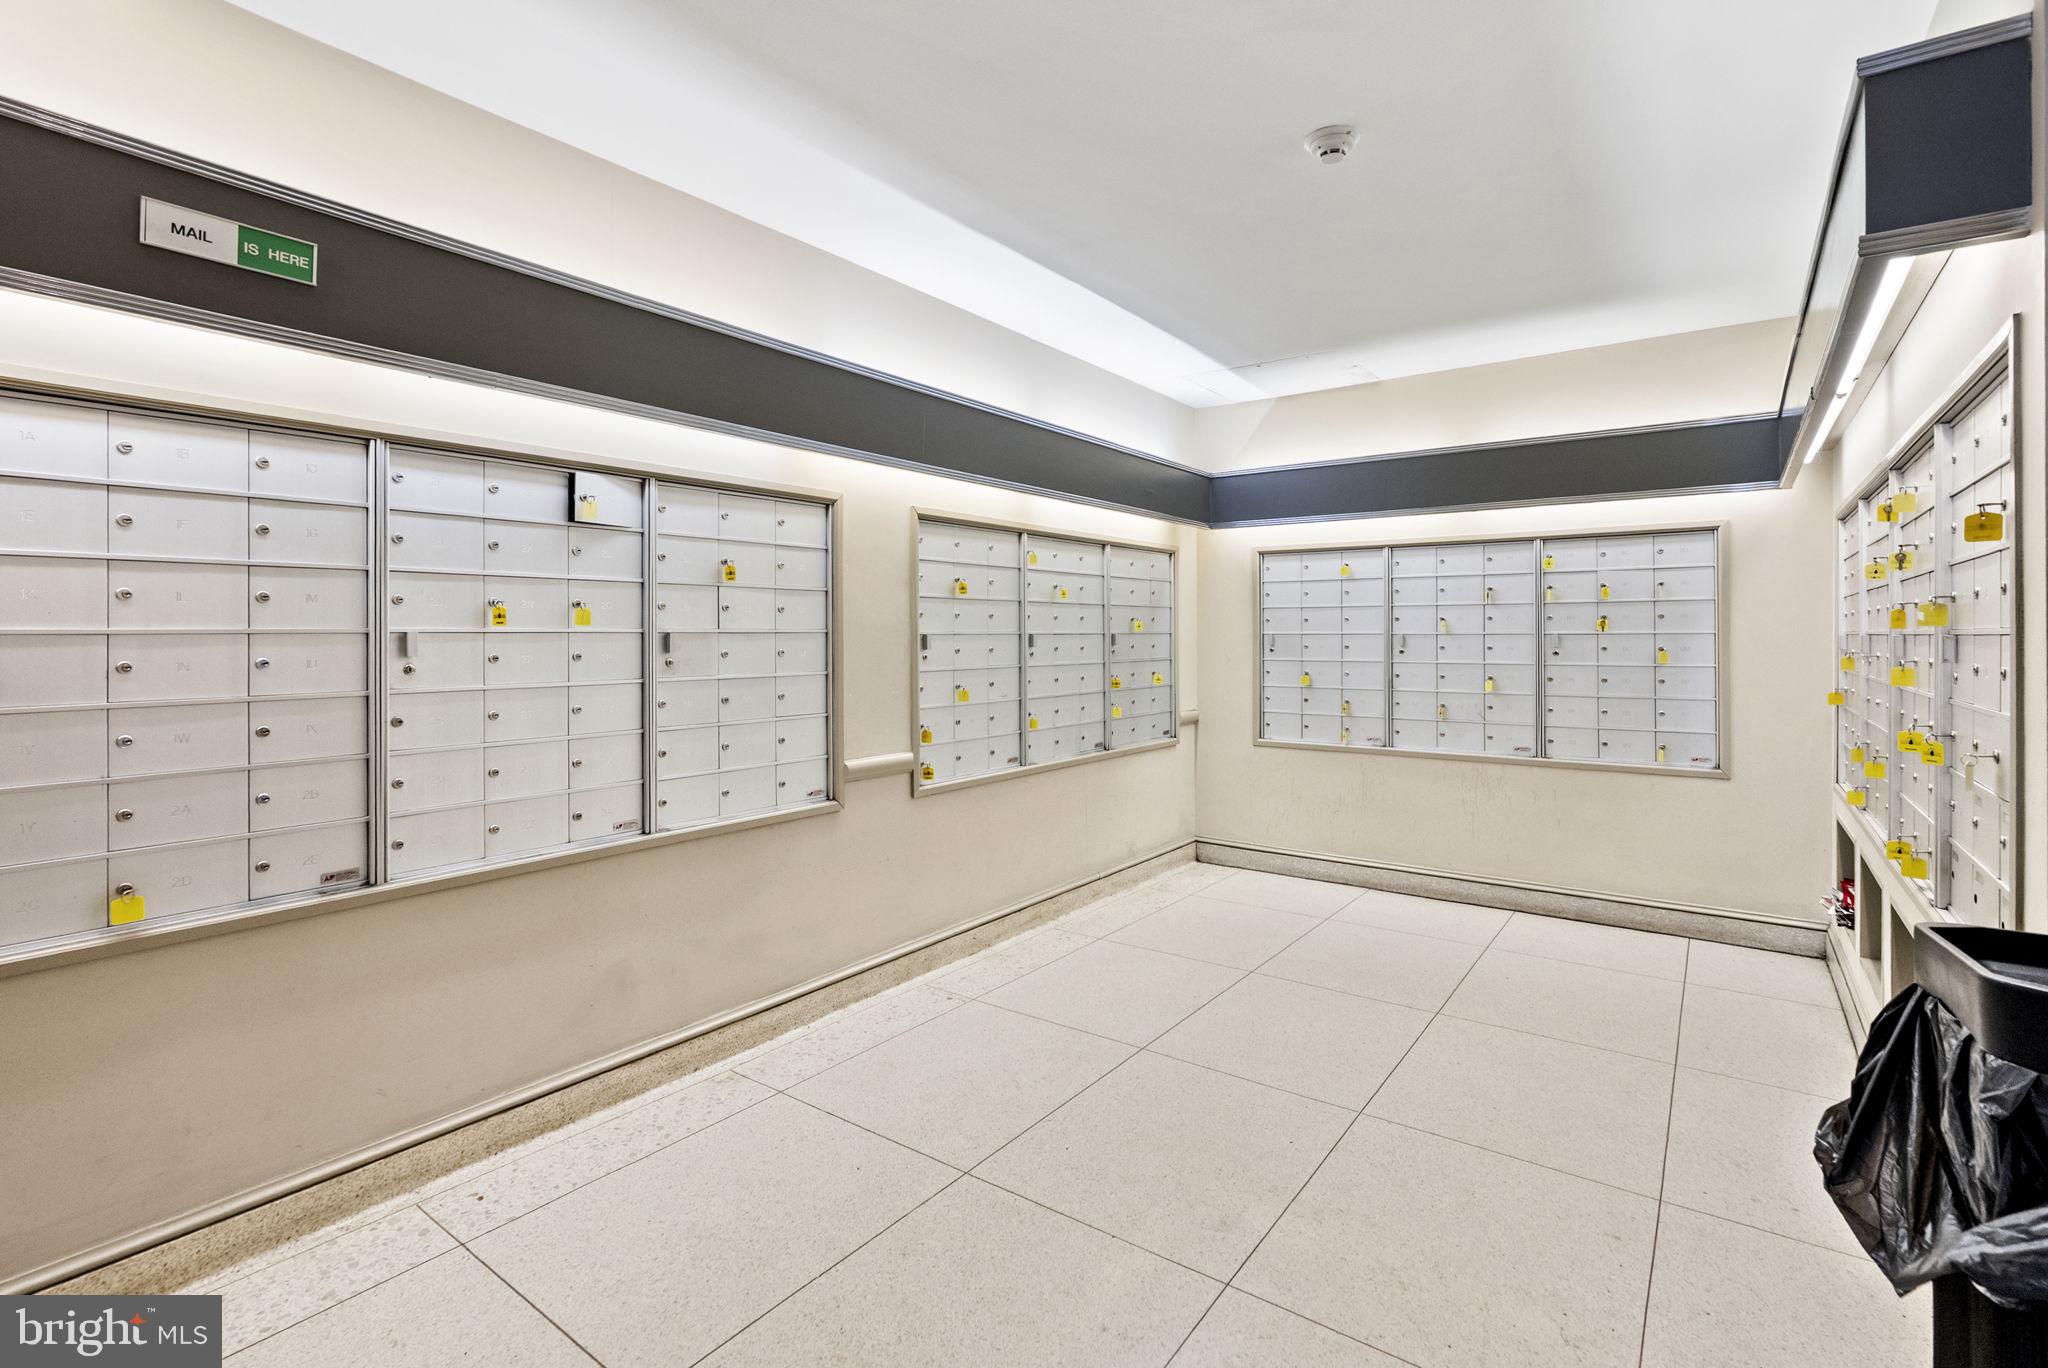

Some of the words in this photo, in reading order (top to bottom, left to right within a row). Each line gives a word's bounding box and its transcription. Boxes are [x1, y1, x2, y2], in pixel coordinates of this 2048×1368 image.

[171, 222, 213, 244] MAIL
[244, 241, 259, 256] IS
[268, 248, 310, 269] HERE
[19, 430, 36, 441] 1A
[176, 448, 189, 459] 1B
[306, 464, 317, 473] 1C
[19, 510, 34, 521] 1E
[176, 520, 190, 528] 1F
[306, 528, 317, 537] 1G
[19, 588, 36, 600] 1K
[176, 592, 186, 602] 1L
[305, 594, 318, 603] 1M
[176, 662, 190, 672] 1N
[173, 734, 191, 743] 1W
[171, 805, 191, 816] 2A
[302, 855, 319, 865] 2E
[172, 876, 192, 887] 2D
